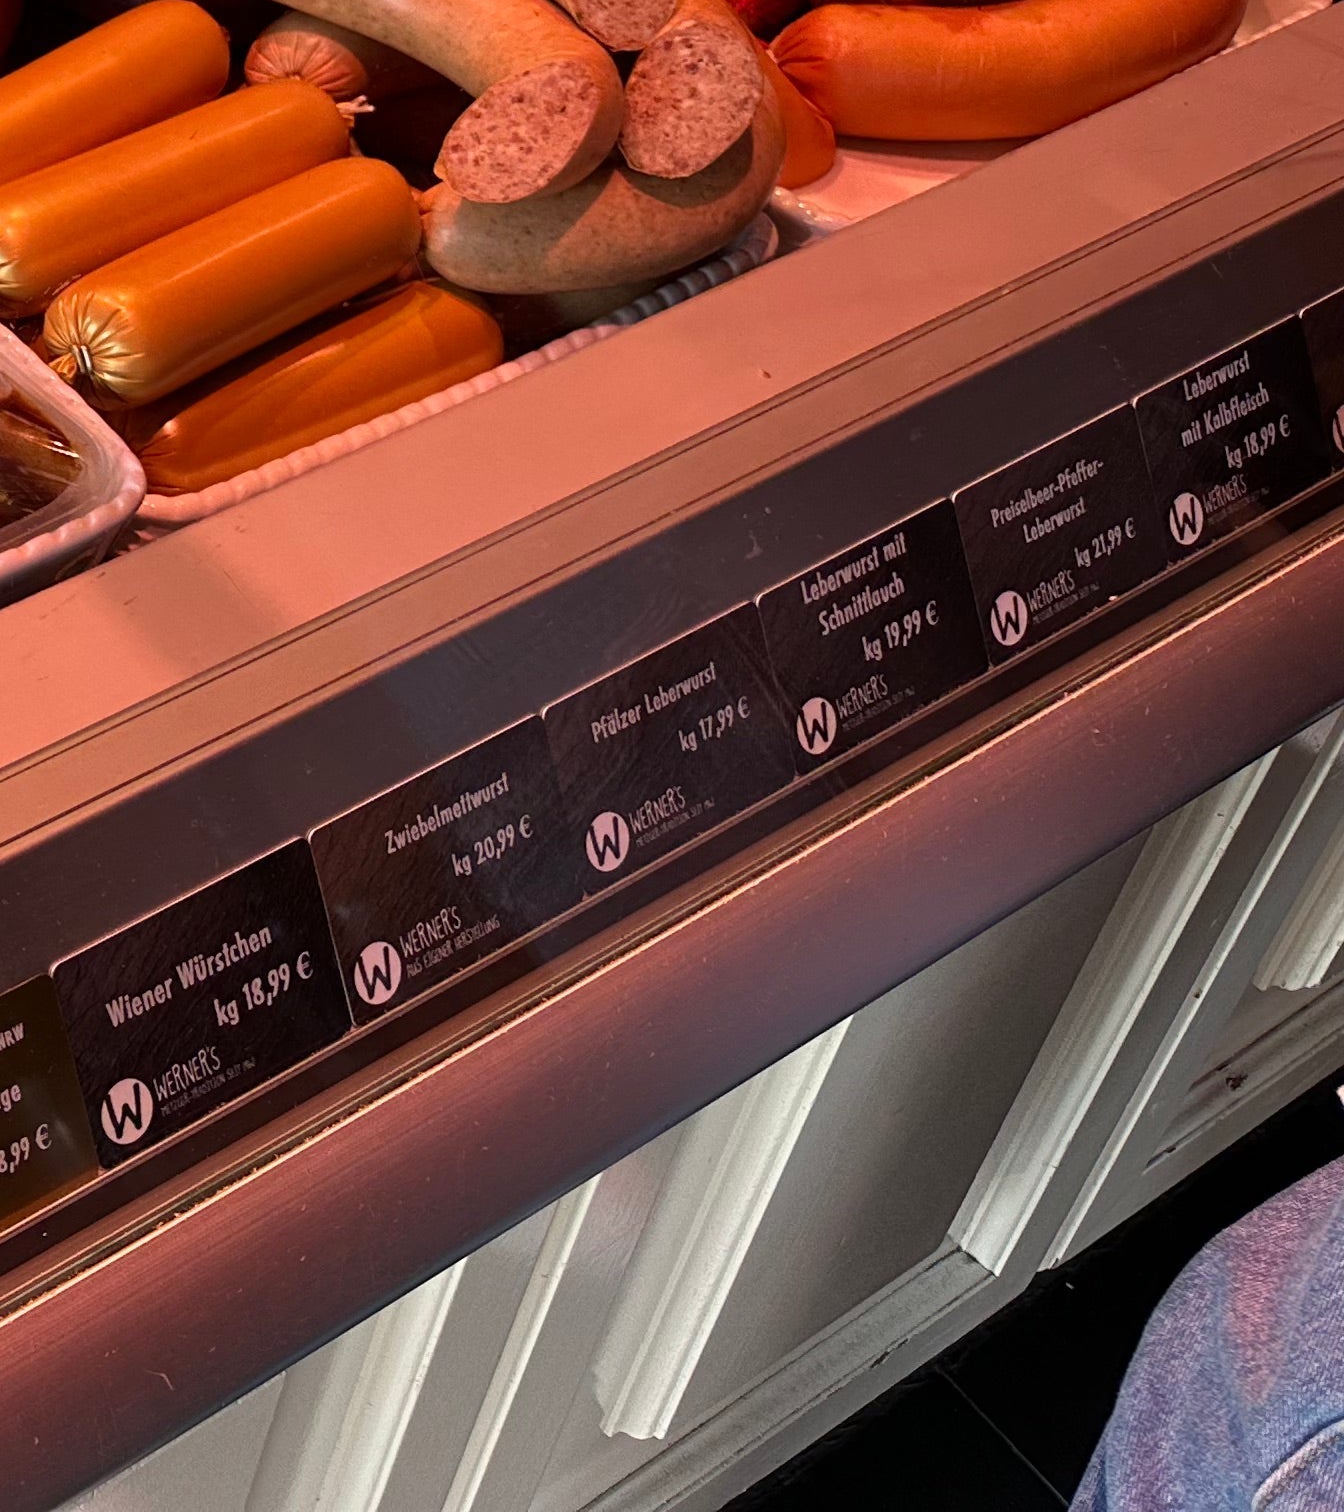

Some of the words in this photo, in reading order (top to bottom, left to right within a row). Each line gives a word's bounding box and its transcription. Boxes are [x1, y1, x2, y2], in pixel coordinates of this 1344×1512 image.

[1182, 349, 1250, 401] Leberwurst
[1180, 419, 1202, 448] mit
[1202, 380, 1270, 435] Kalbfleisch
[1224, 444, 1243, 469] kg
[1242, 421, 1276, 458] 18,99
[1278, 413, 1290, 438] €
[1022, 495, 1086, 544] Leberwurst
[1201, 472, 1247, 514] WERNER'S
[799, 545, 880, 605] Leberwurst
[881, 530, 907, 562] mit
[1073, 546, 1091, 568] kg
[1090, 524, 1122, 559] 21,99
[1124, 516, 1136, 539] €
[817, 570, 905, 636] Schnittlauch
[1025, 568, 1075, 613] WERNER'S
[860, 635, 883, 662] kg
[883, 608, 921, 649] 19,99
[924, 599, 939, 626] €
[589, 703, 642, 743] Pfälzer
[642, 660, 717, 714] Leberwurst
[677, 729, 698, 752] kg
[697, 703, 734, 741] 17,99
[736, 694, 751, 719] €
[834, 673, 888, 720] WERNER'S
[383, 770, 509, 854] Zwiebelmettwurst
[627, 784, 686, 835] WERNER'S
[450, 852, 472, 877] kg
[472, 822, 515, 865] 20,99
[517, 813, 533, 839] €
[398, 904, 462, 958] WERNER'S
[104, 976, 173, 1028] Wiener
[174, 925, 272, 990] Würstchen
[212, 997, 240, 1027] kg
[241, 961, 290, 1011] 18,99
[295, 949, 314, 980] €
[151, 1045, 221, 1102] WERNER'S
[34, 1122, 52, 1150] €
